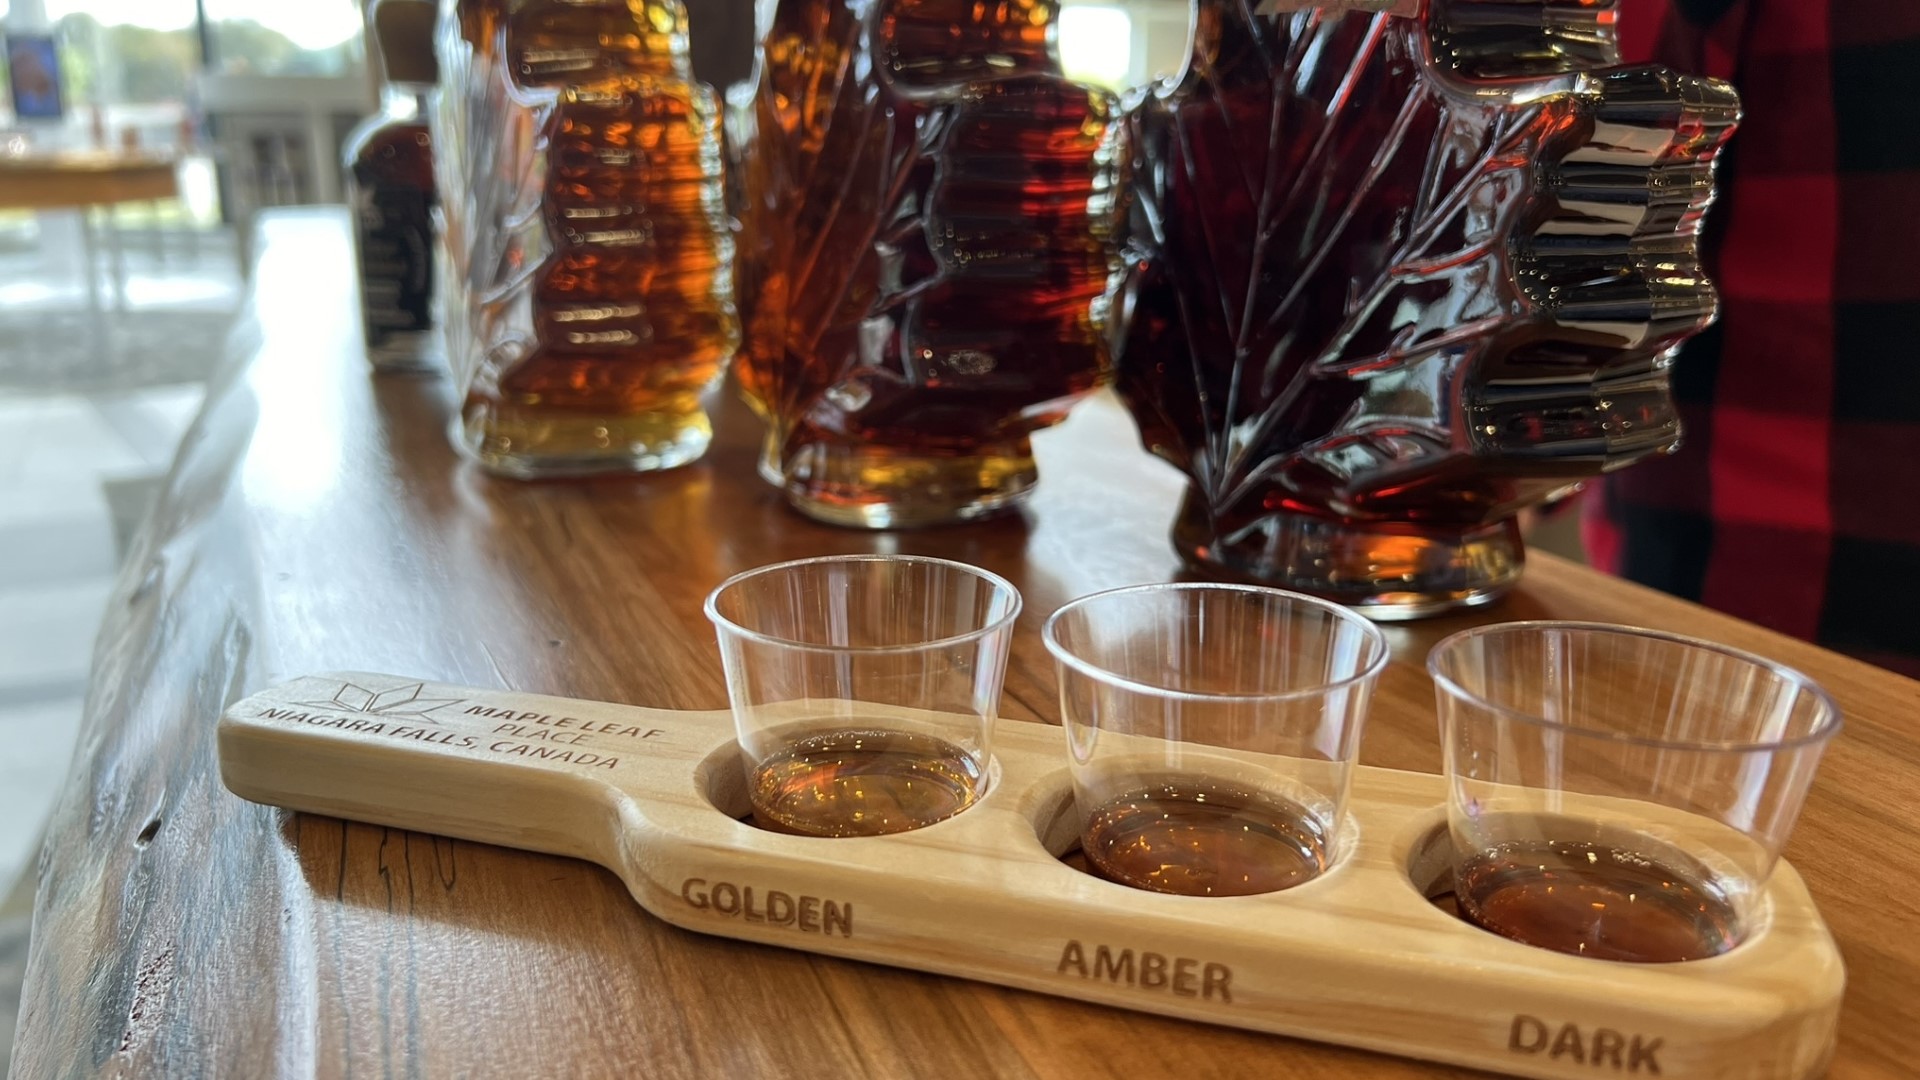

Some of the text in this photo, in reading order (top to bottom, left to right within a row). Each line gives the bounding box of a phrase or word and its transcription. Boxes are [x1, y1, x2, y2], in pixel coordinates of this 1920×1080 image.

[258, 708, 620, 769] NIAGARA FALLS, CANADA
[464, 706, 665, 739] MAPLE LEAF
[493, 723, 594, 745] PLACE
[681, 877, 853, 938] GOLDEN
[1056, 939, 1233, 1003] AMBER
[1508, 1014, 1665, 1076] DARK
